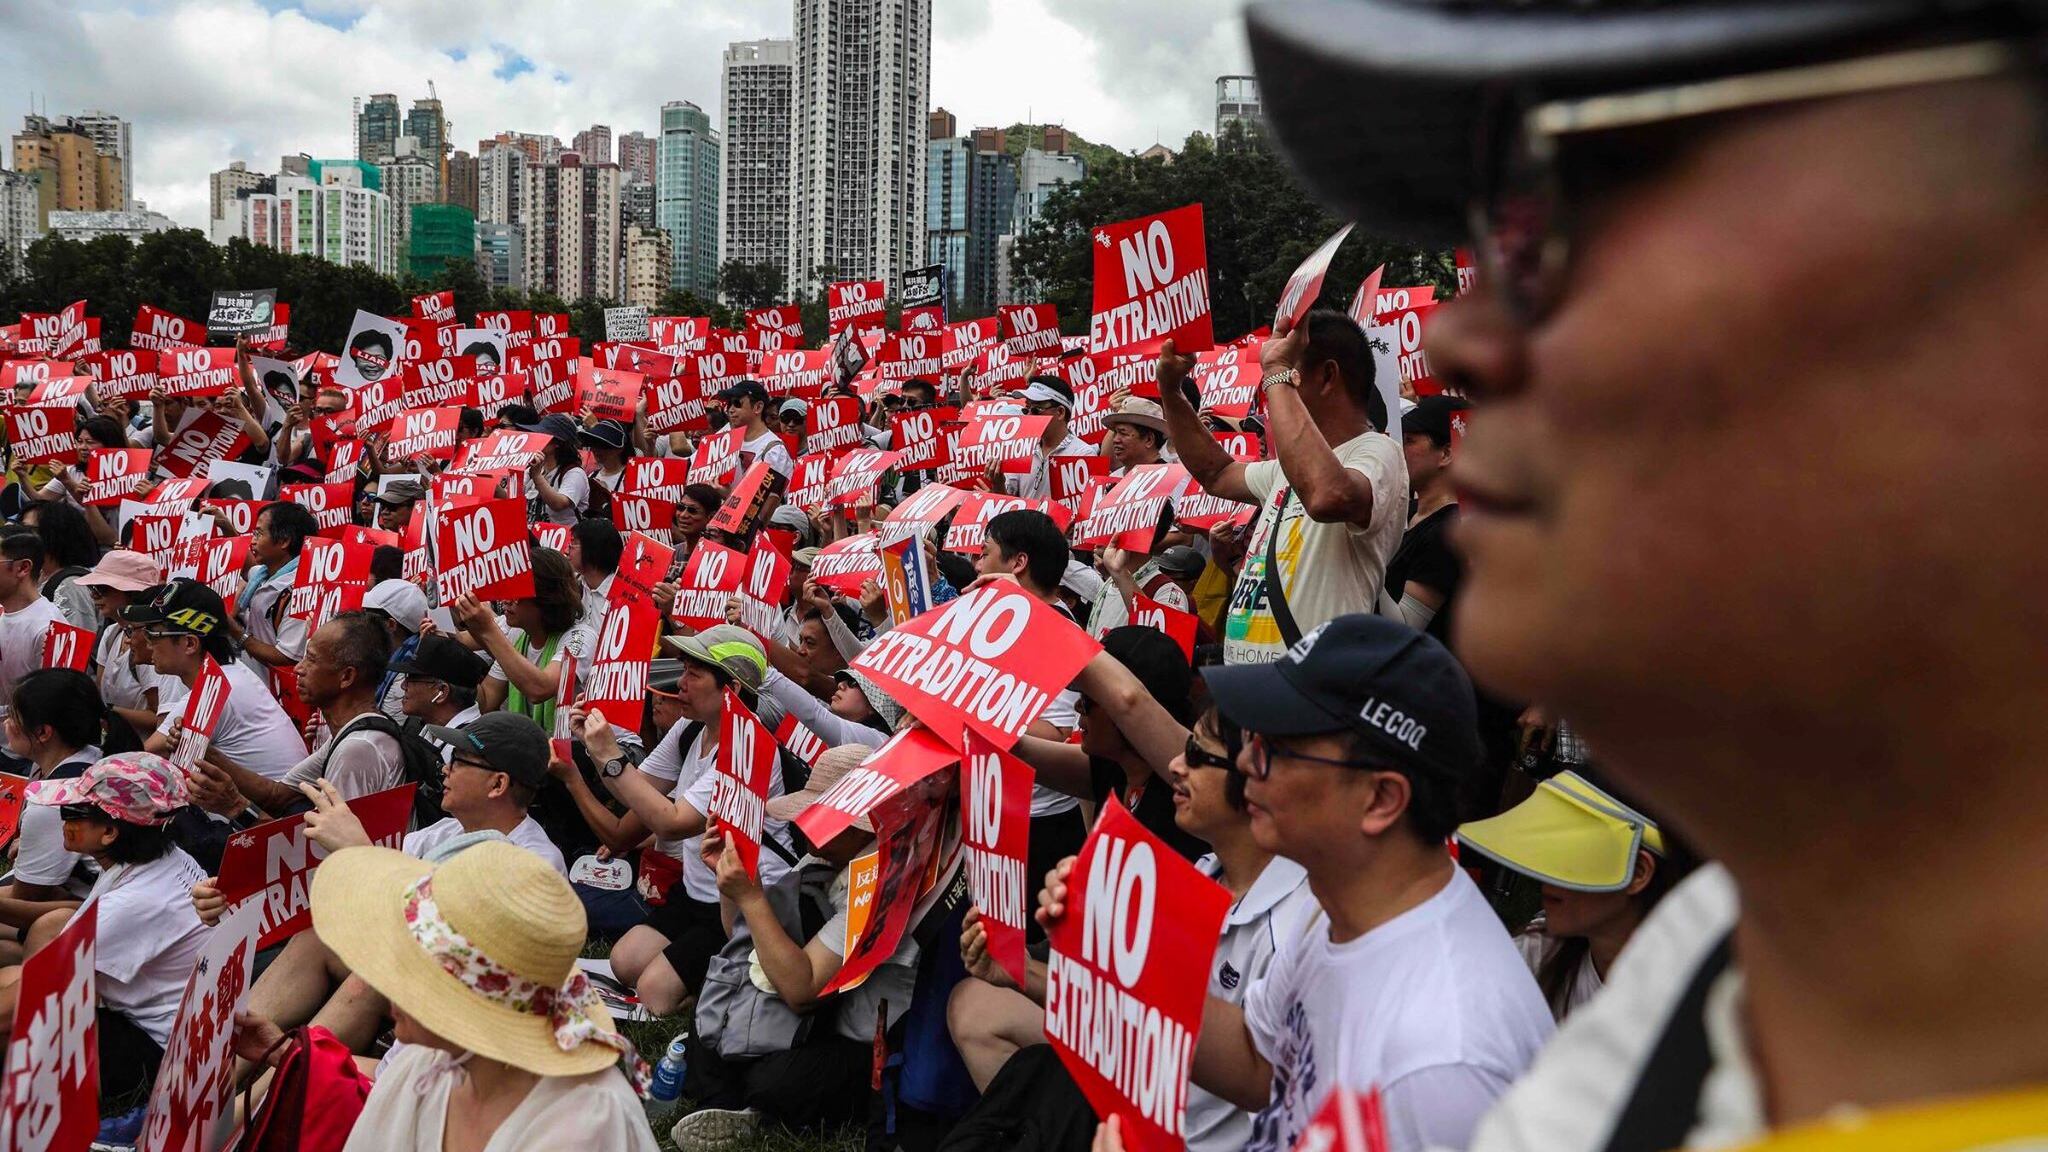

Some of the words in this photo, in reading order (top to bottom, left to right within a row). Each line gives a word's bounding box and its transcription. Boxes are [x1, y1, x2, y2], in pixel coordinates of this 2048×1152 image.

[1119, 219, 1175, 298] NO
[420, 294, 441, 316] NO
[840, 283, 867, 304] NO
[1376, 289, 1410, 316] NO
[61, 307, 75, 334] NO
[484, 313, 511, 334] NO
[756, 309, 783, 329] NO
[829, 297, 886, 322] EXTRADITION!
[1010, 307, 1039, 335] NO
[1091, 267, 1210, 354] EXTRADITION!
[34, 316, 60, 338] NO
[151, 314, 186, 341] NO
[540, 315, 556, 337] NO
[674, 320, 696, 343] NO
[759, 330, 782, 351] NO
[954, 321, 981, 348] NO
[533, 340, 562, 362] NO
[723, 334, 748, 353] NO
[900, 335, 926, 360] NO
[1004, 327, 1061, 356] EXTRADITION!
[110, 352, 137, 379] NO
[177, 350, 211, 374] NO
[357, 351, 386, 366] LIAR
[476, 364, 496, 372] IAR
[697, 352, 727, 380] NO
[774, 351, 806, 375] NO
[883, 358, 941, 378] EXTRADITION!
[987, 343, 1010, 371] NO
[1068, 356, 1096, 387] NO
[16, 363, 50, 384] NO
[160, 368, 234, 394] EXTRADITION!
[418, 359, 454, 387] NO
[533, 361, 553, 391] NO
[1203, 365, 1240, 394] NO
[41, 378, 74, 401] NO
[362, 382, 385, 413] NO
[405, 378, 468, 408] EXTRADITIO
[478, 377, 505, 405] NO
[581, 389, 594, 400] No
[595, 390, 626, 405] China
[656, 378, 683, 409] NO
[1072, 384, 1099, 419] NO
[1200, 386, 1256, 408] RADITION!
[15, 409, 49, 437] NO
[406, 410, 437, 434] NO
[648, 398, 707, 430] EXTRADITION!
[816, 400, 840, 431] NO
[807, 423, 862, 454] EXTRADITION!
[901, 412, 934, 446] NO
[979, 416, 1021, 443] NO
[171, 429, 211, 465] NO
[334, 442, 353, 470] NO
[389, 429, 456, 460] EXTRADITION!
[492, 434, 529, 456] NO
[707, 432, 731, 464] NO
[893, 437, 937, 471] EXTRADIT
[956, 437, 1040, 470] EXTRADITION!
[99, 450, 129, 478] NO
[636, 459, 665, 489] NO
[842, 452, 883, 475] NO
[1060, 459, 1089, 497] NO
[157, 479, 193, 503] NO
[294, 486, 327, 512] NO
[1116, 466, 1169, 504] NO
[623, 499, 651, 530] NO
[900, 489, 950, 519] NO
[1083, 496, 1169, 539] EXTRADITION!
[146, 518, 172, 551] NO
[453, 506, 495, 562] NO
[206, 540, 233, 583] NO
[308, 543, 345, 583] NO
[438, 540, 533, 602] EXTRADITION!
[693, 551, 729, 589] NO
[750, 549, 777, 600] NO
[168, 606, 219, 634] 46
[318, 586, 342, 628] NO
[597, 605, 630, 661] NO
[928, 584, 1031, 660] NO
[584, 660, 648, 702] RADITION!
[855, 631, 1048, 738] EXTRADITION!
[192, 675, 223, 731] NO
[731, 713, 755, 785] NO
[710, 770, 765, 845] EXTRADITION!
[970, 752, 1003, 849] NO
[1082, 833, 1156, 989] NO
[1046, 948, 1192, 1137] EXTRADITION!
